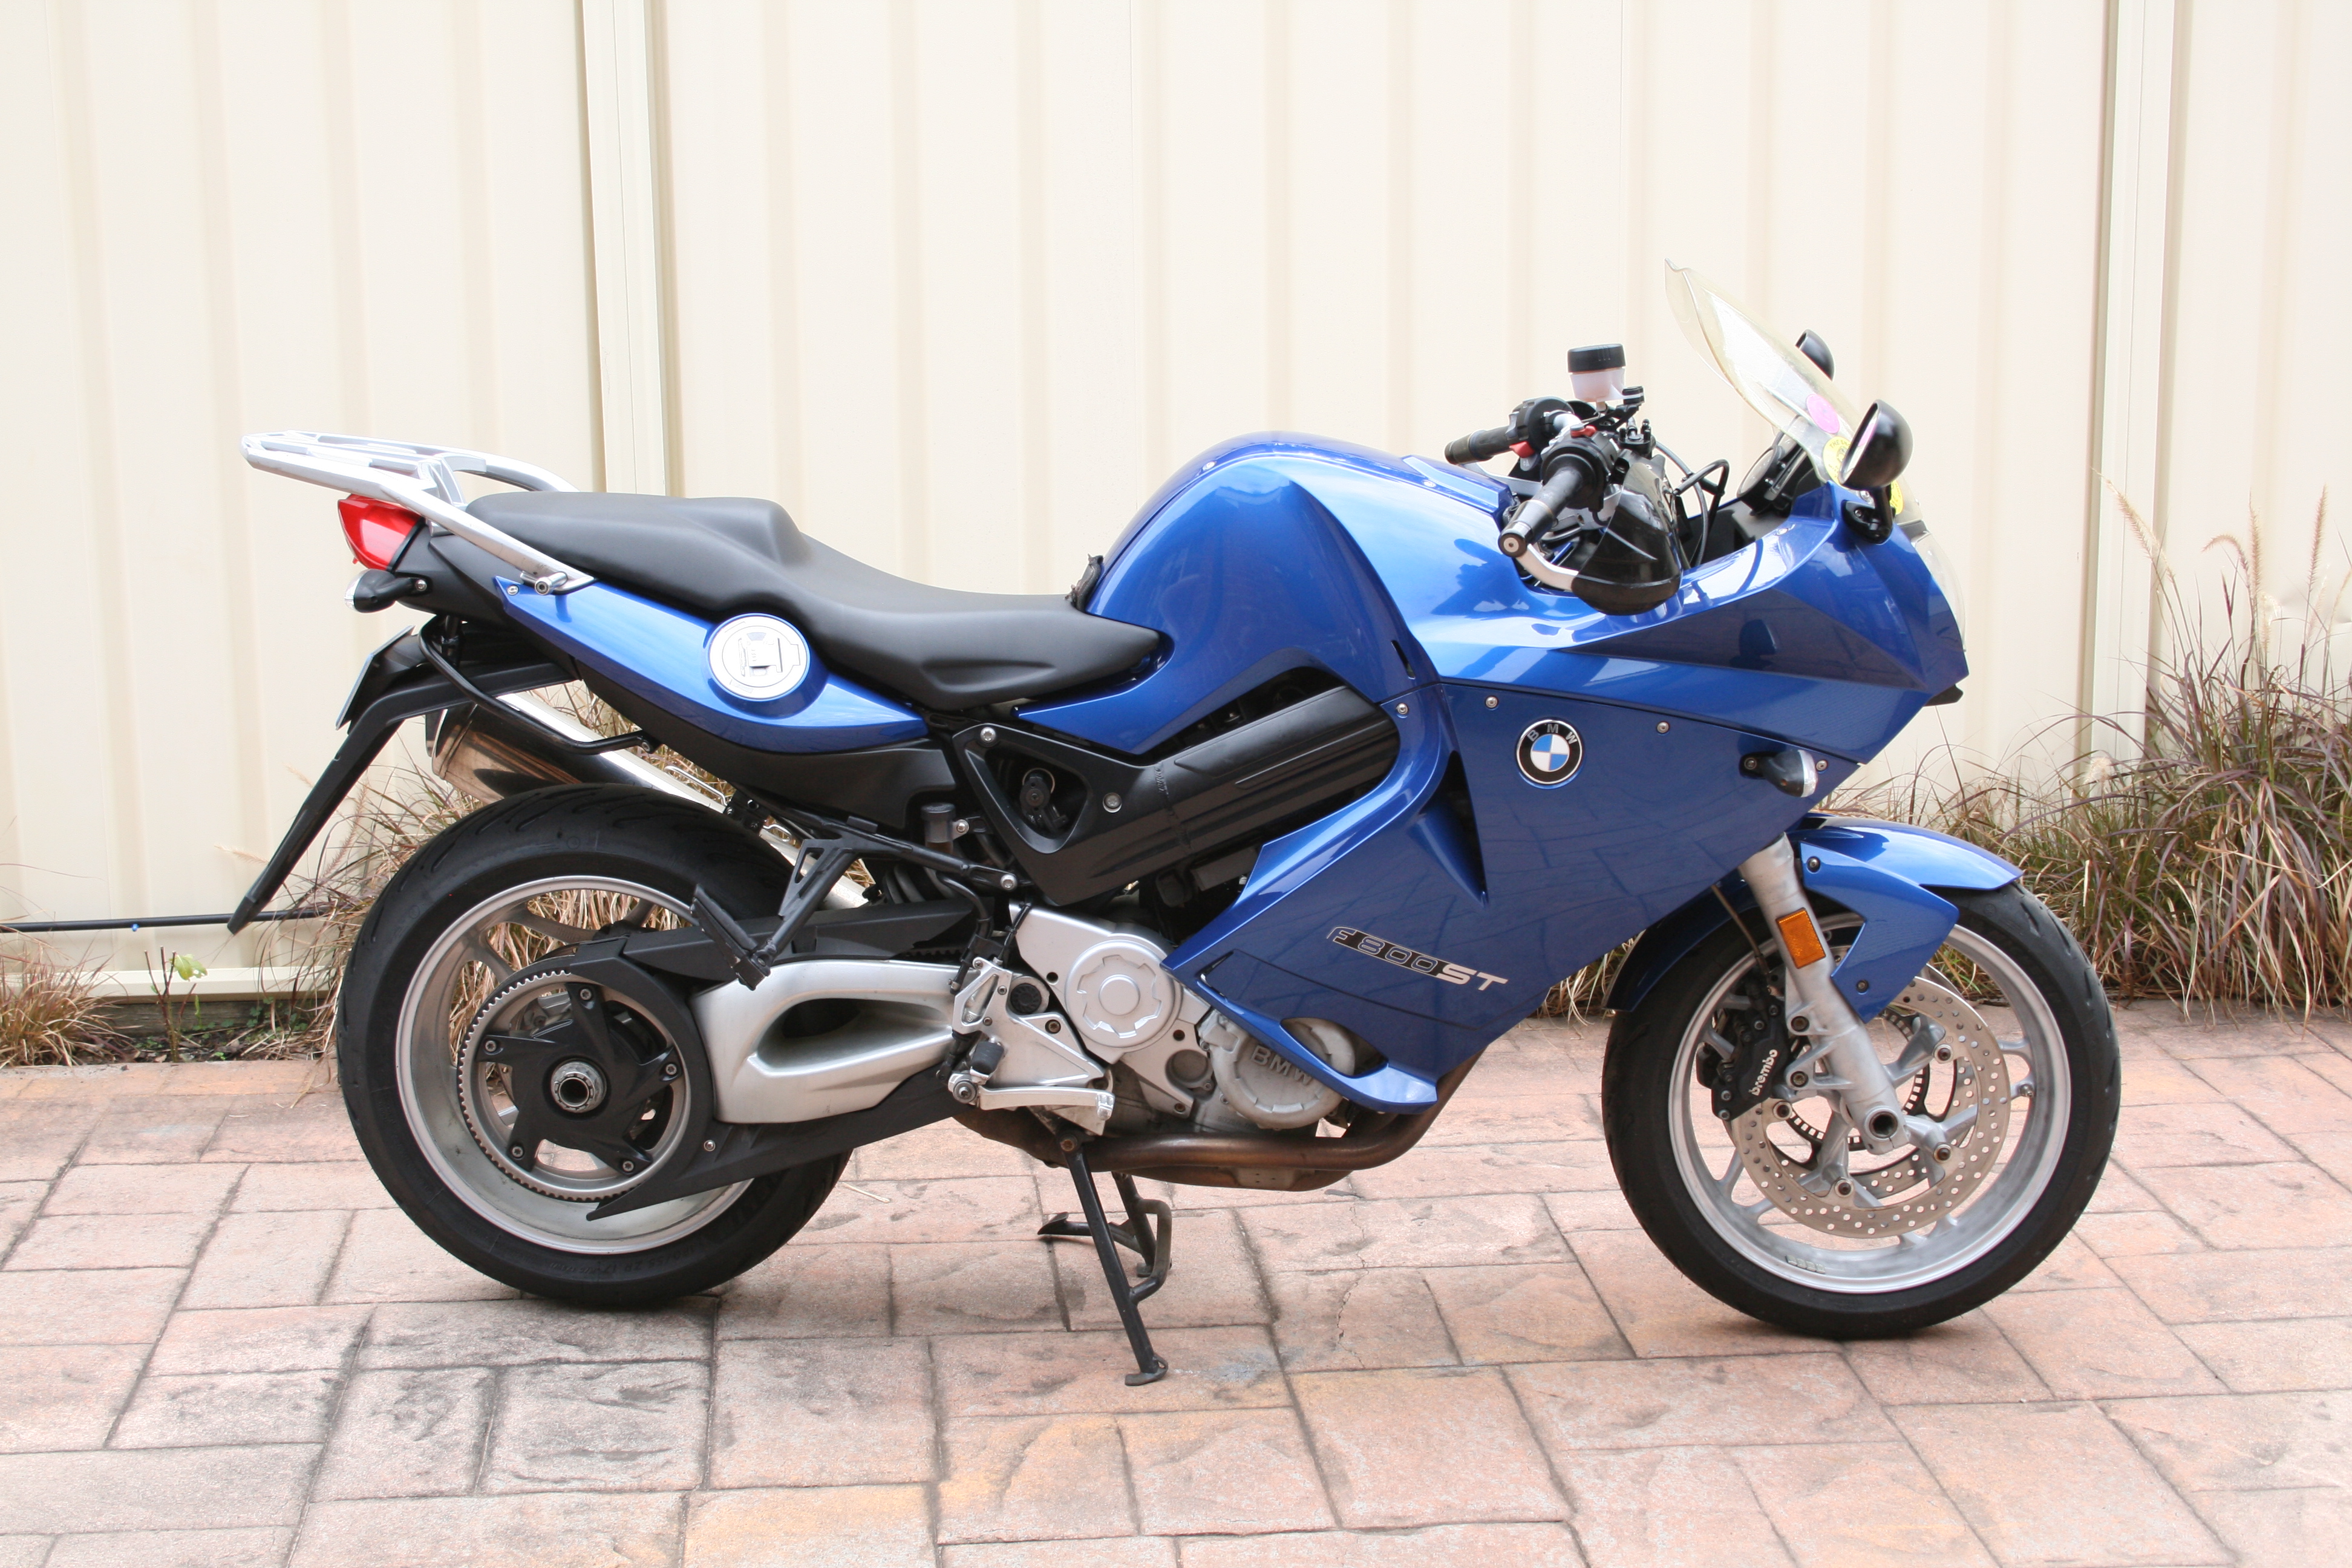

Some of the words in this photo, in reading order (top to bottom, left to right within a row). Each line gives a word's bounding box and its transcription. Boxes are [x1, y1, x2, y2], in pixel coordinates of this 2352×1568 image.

[1527, 724, 1578, 745] BMW
[1250, 1045, 1313, 1086] BMW
[1748, 1048, 1780, 1096] brembo
